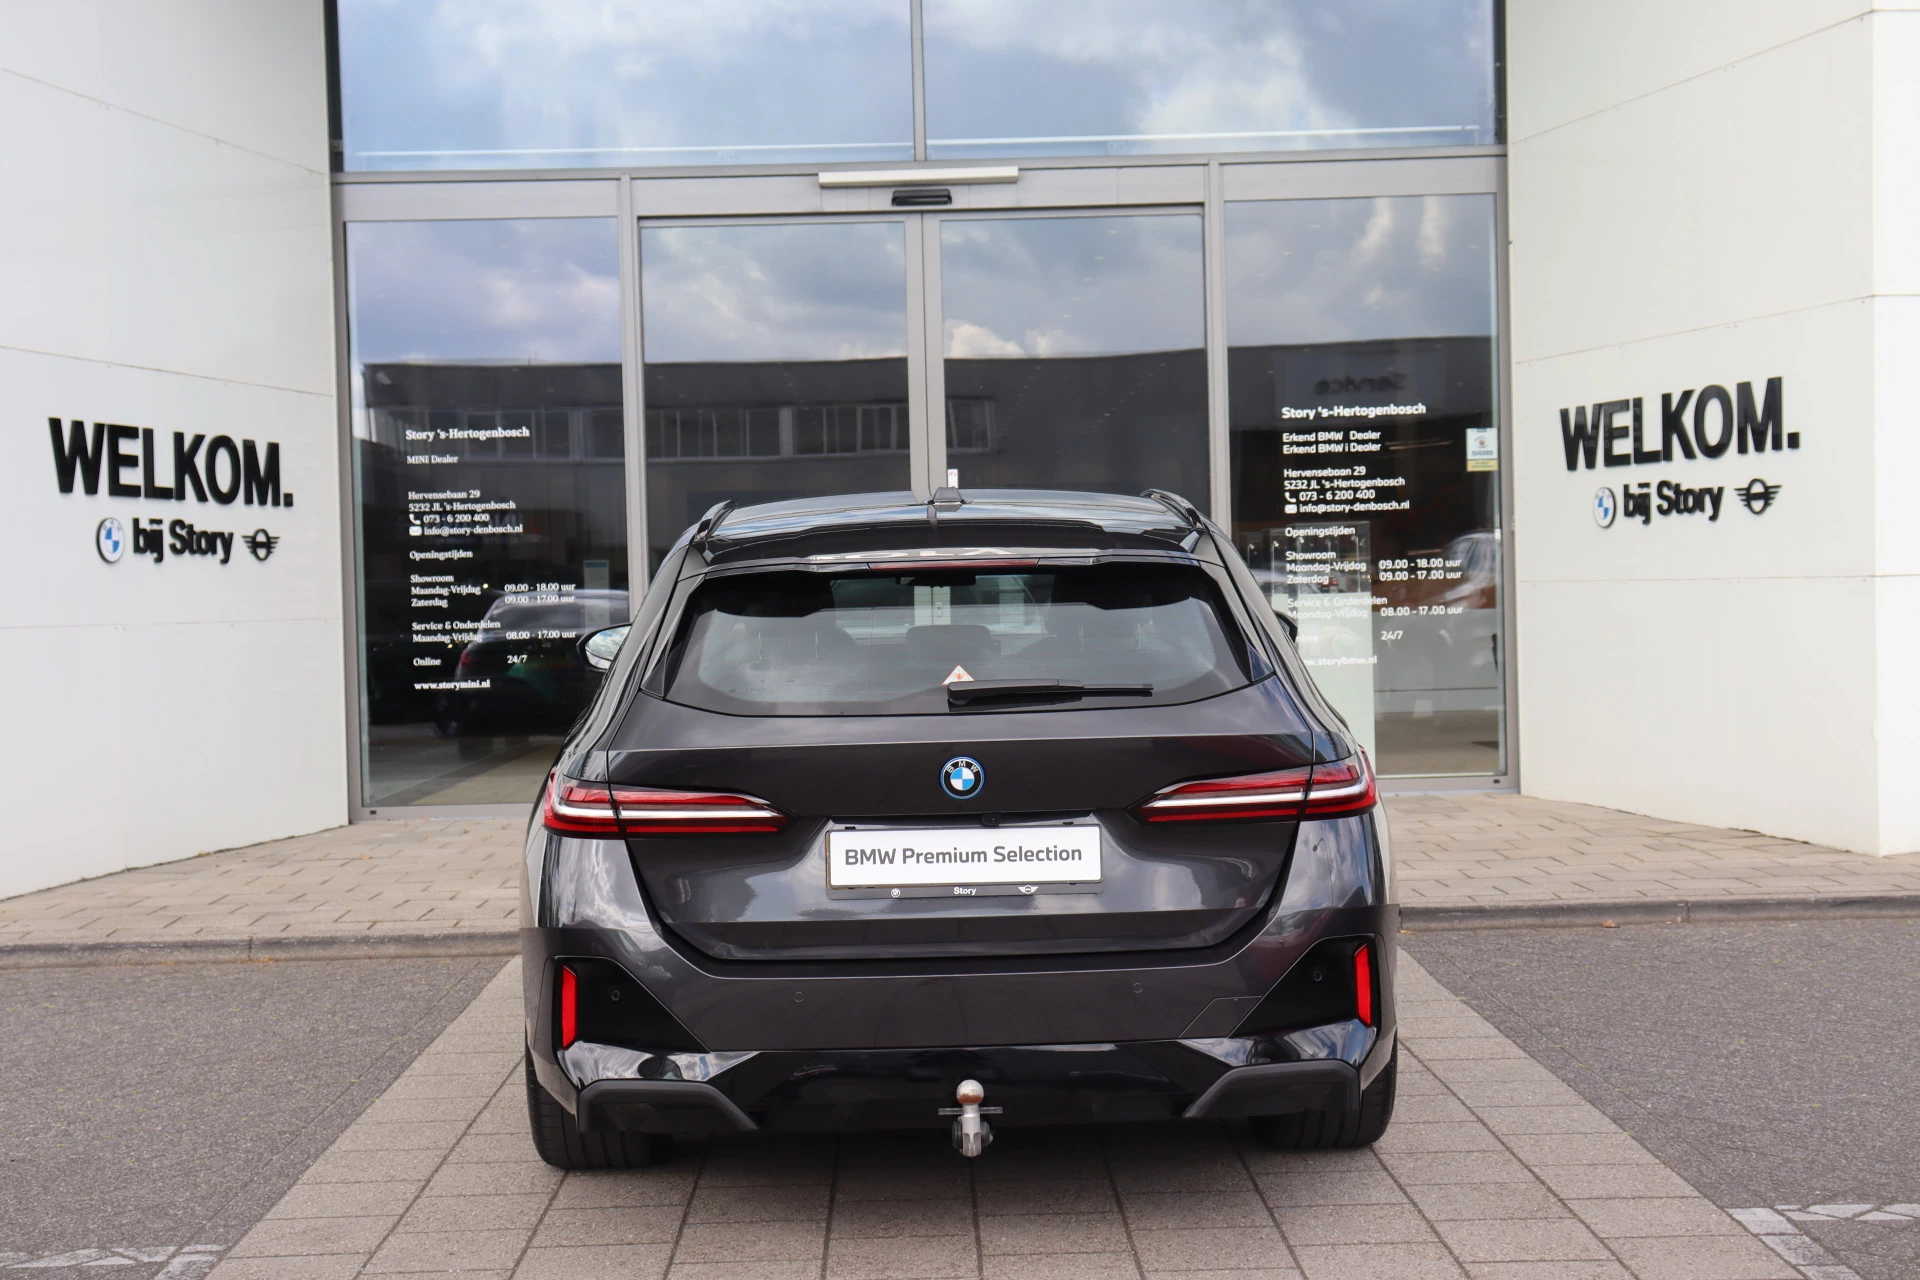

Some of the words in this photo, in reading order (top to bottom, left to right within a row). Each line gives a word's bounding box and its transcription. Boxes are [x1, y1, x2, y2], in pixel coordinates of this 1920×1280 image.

[1281, 407, 1316, 420] Story
[1560, 376, 1800, 472] WELKOM.
[405, 429, 435, 442] Story
[1282, 432, 1316, 443] Erkend
[1318, 431, 1343, 442] BMW
[1349, 430, 1381, 441] Dealer
[1282, 444, 1316, 455] Erkend
[1318, 443, 1343, 454] BMW
[1350, 442, 1381, 452] Dealer
[48, 417, 293, 507] WELKOM.
[407, 455, 429, 464] MINI
[431, 455, 458, 464] Dealer
[1283, 467, 1352, 478] Hervensebaan
[1353, 466, 1366, 476] 29
[1284, 480, 1308, 490] 5232
[1309, 480, 1320, 489] JL
[408, 491, 467, 500] Hervensebaan
[469, 490, 480, 498] 29
[1299, 491, 1317, 501] 073
[1326, 491, 1333, 500] 6
[1334, 490, 1354, 500] 200
[1355, 489, 1375, 499] 400
[409, 502, 430, 511] 5232
[431, 502, 443, 511] JL
[1299, 500, 1410, 514] info@story-denbosch.nl
[1623, 482, 1651, 525] bij
[1656, 480, 1725, 522] Story
[423, 514, 440, 523] 073
[447, 514, 453, 522] 6
[455, 514, 471, 522] 200
[473, 513, 490, 522] 400
[424, 524, 523, 537] info@story-denbosch.nl
[1285, 526, 1356, 539] Openingstijden
[133, 517, 163, 563] bij
[169, 519, 234, 564] Story
[409, 550, 473, 561] Openingstijden
[1285, 550, 1336, 561] Showroom
[1286, 561, 1367, 573] Maandag-Vrijdag
[1379, 559, 1408, 570] 09.00
[1416, 558, 1444, 568] 18.00
[1445, 559, 1462, 568] uur
[410, 574, 454, 583] Showroom
[1286, 574, 1330, 585] Zaterdag
[1379, 571, 1408, 581] 09.00
[1446, 570, 1462, 579] uur
[411, 585, 481, 595] Maandag-Vrijdag
[504, 584, 529, 592] 09.00
[536, 583, 559, 592] 18.00
[561, 583, 576, 591] uur
[411, 599, 448, 608] Zaterdag
[505, 596, 529, 604] 09.00
[536, 595, 559, 604] 17.00
[1287, 597, 1321, 608] Service
[1334, 596, 1388, 606] Onderdelen
[1288, 607, 1368, 619] Maandag-Vrijdag
[1380, 607, 1410, 617] 08.00
[1447, 606, 1463, 615] uur
[412, 621, 442, 631] Service
[445, 622, 451, 630] &
[453, 620, 501, 629] Onderdelen
[412, 633, 483, 643] Maandag-Vrijdag
[506, 632, 530, 640] 08.00
[537, 631, 560, 639] 17.00
[562, 631, 576, 639] uur
[1296, 634, 1320, 642] nline
[1381, 630, 1403, 640] 24/7
[413, 658, 441, 666] Online
[507, 655, 527, 664] 24/7
[414, 679, 490, 691] www.storymini.nl
[845, 849, 896, 865] BMW
[902, 847, 988, 864] Premium
[993, 845, 1082, 863] Selection
[953, 886, 976, 896] Story
